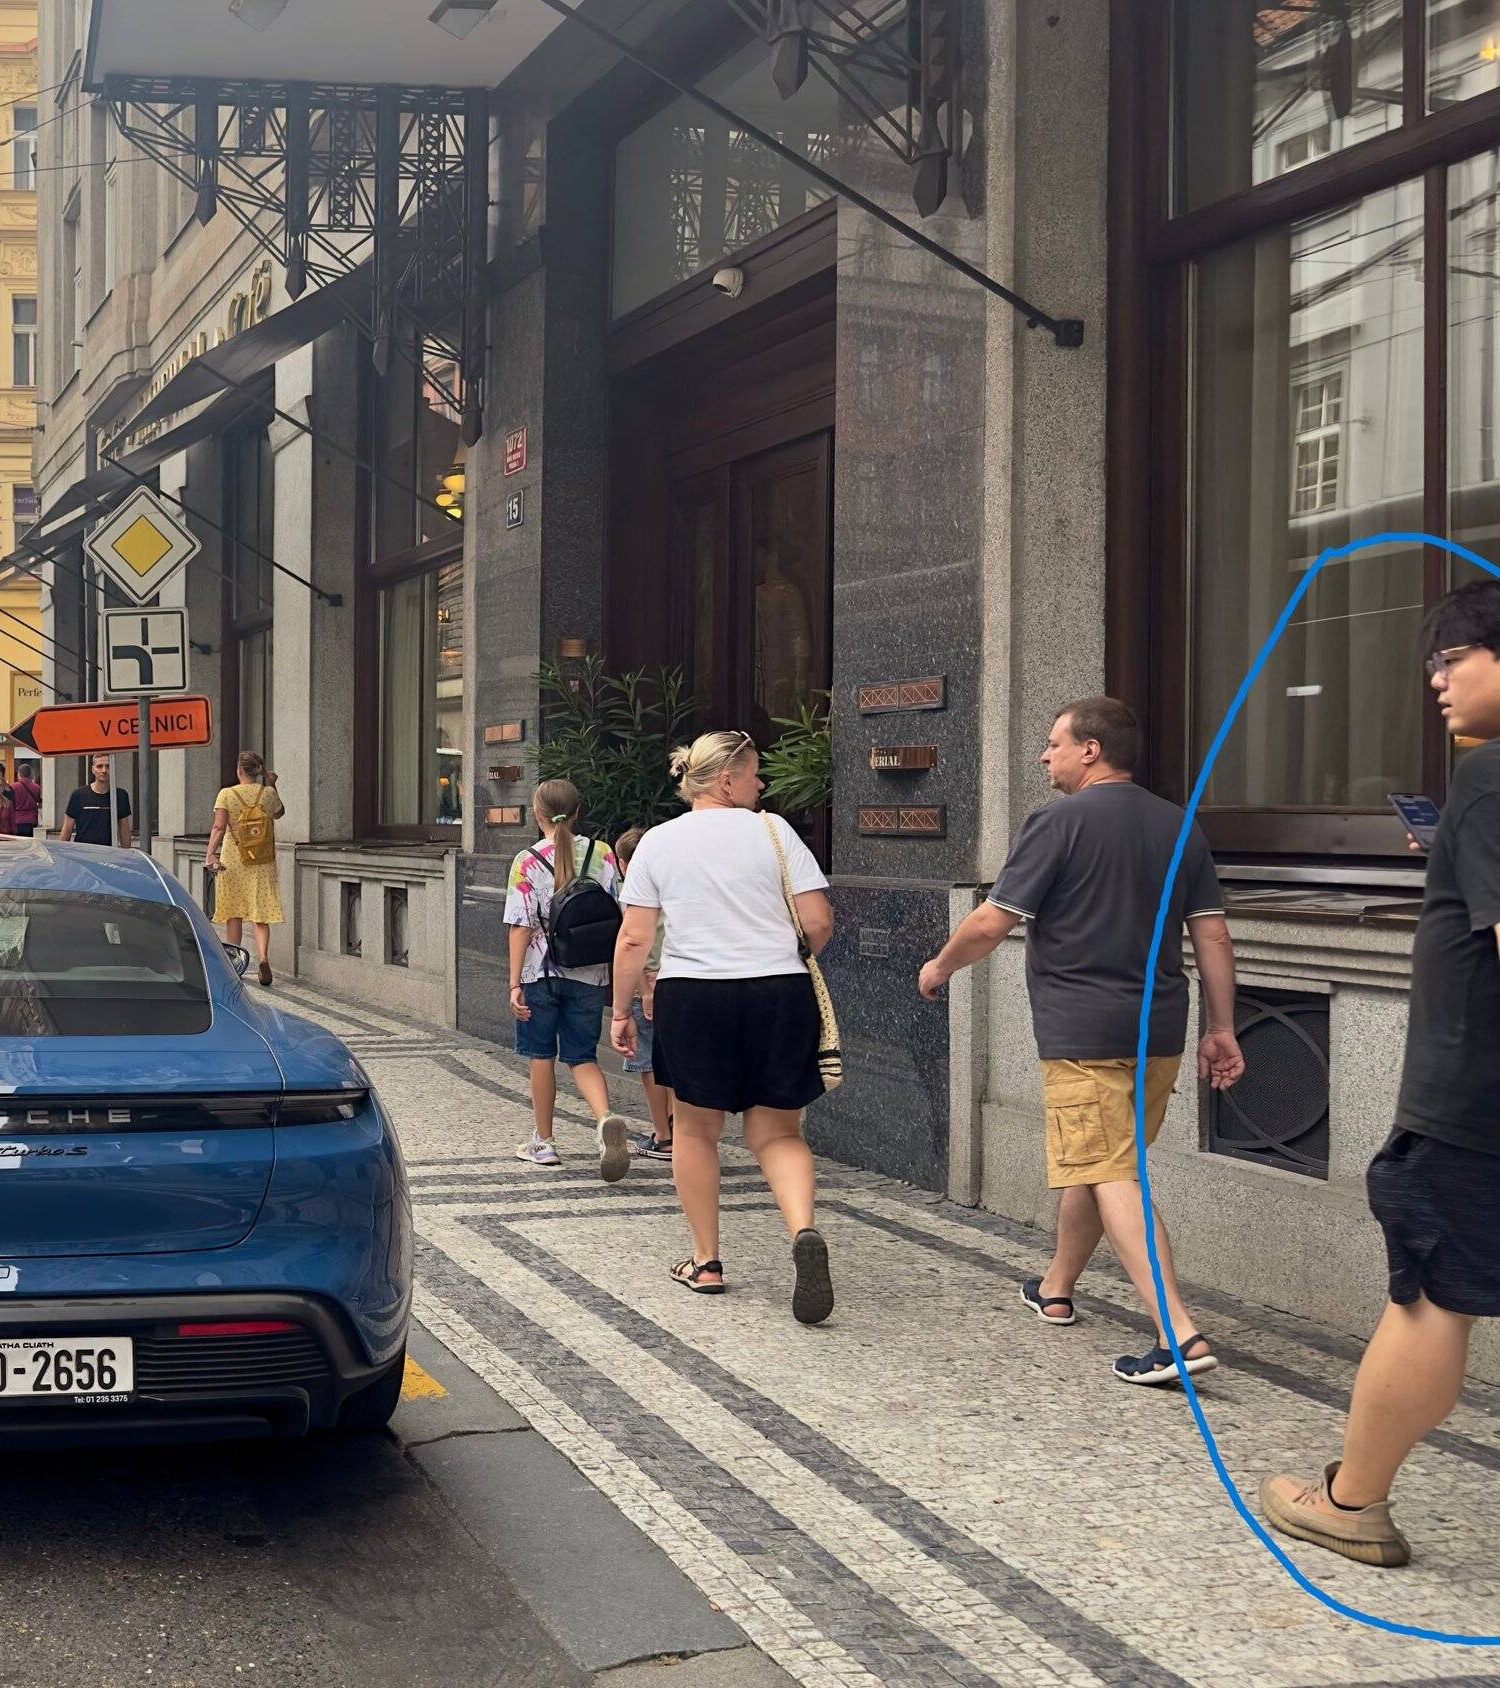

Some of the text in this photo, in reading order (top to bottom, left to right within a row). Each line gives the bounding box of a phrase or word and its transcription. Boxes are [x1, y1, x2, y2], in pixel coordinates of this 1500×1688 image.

[508, 497, 519, 520] 15
[100, 713, 193, 736] V CENICI
[65, 1146, 88, 1156] S
[74, 1396, 85, 1404] Tel:
[110, 1395, 128, 1403] 3375
